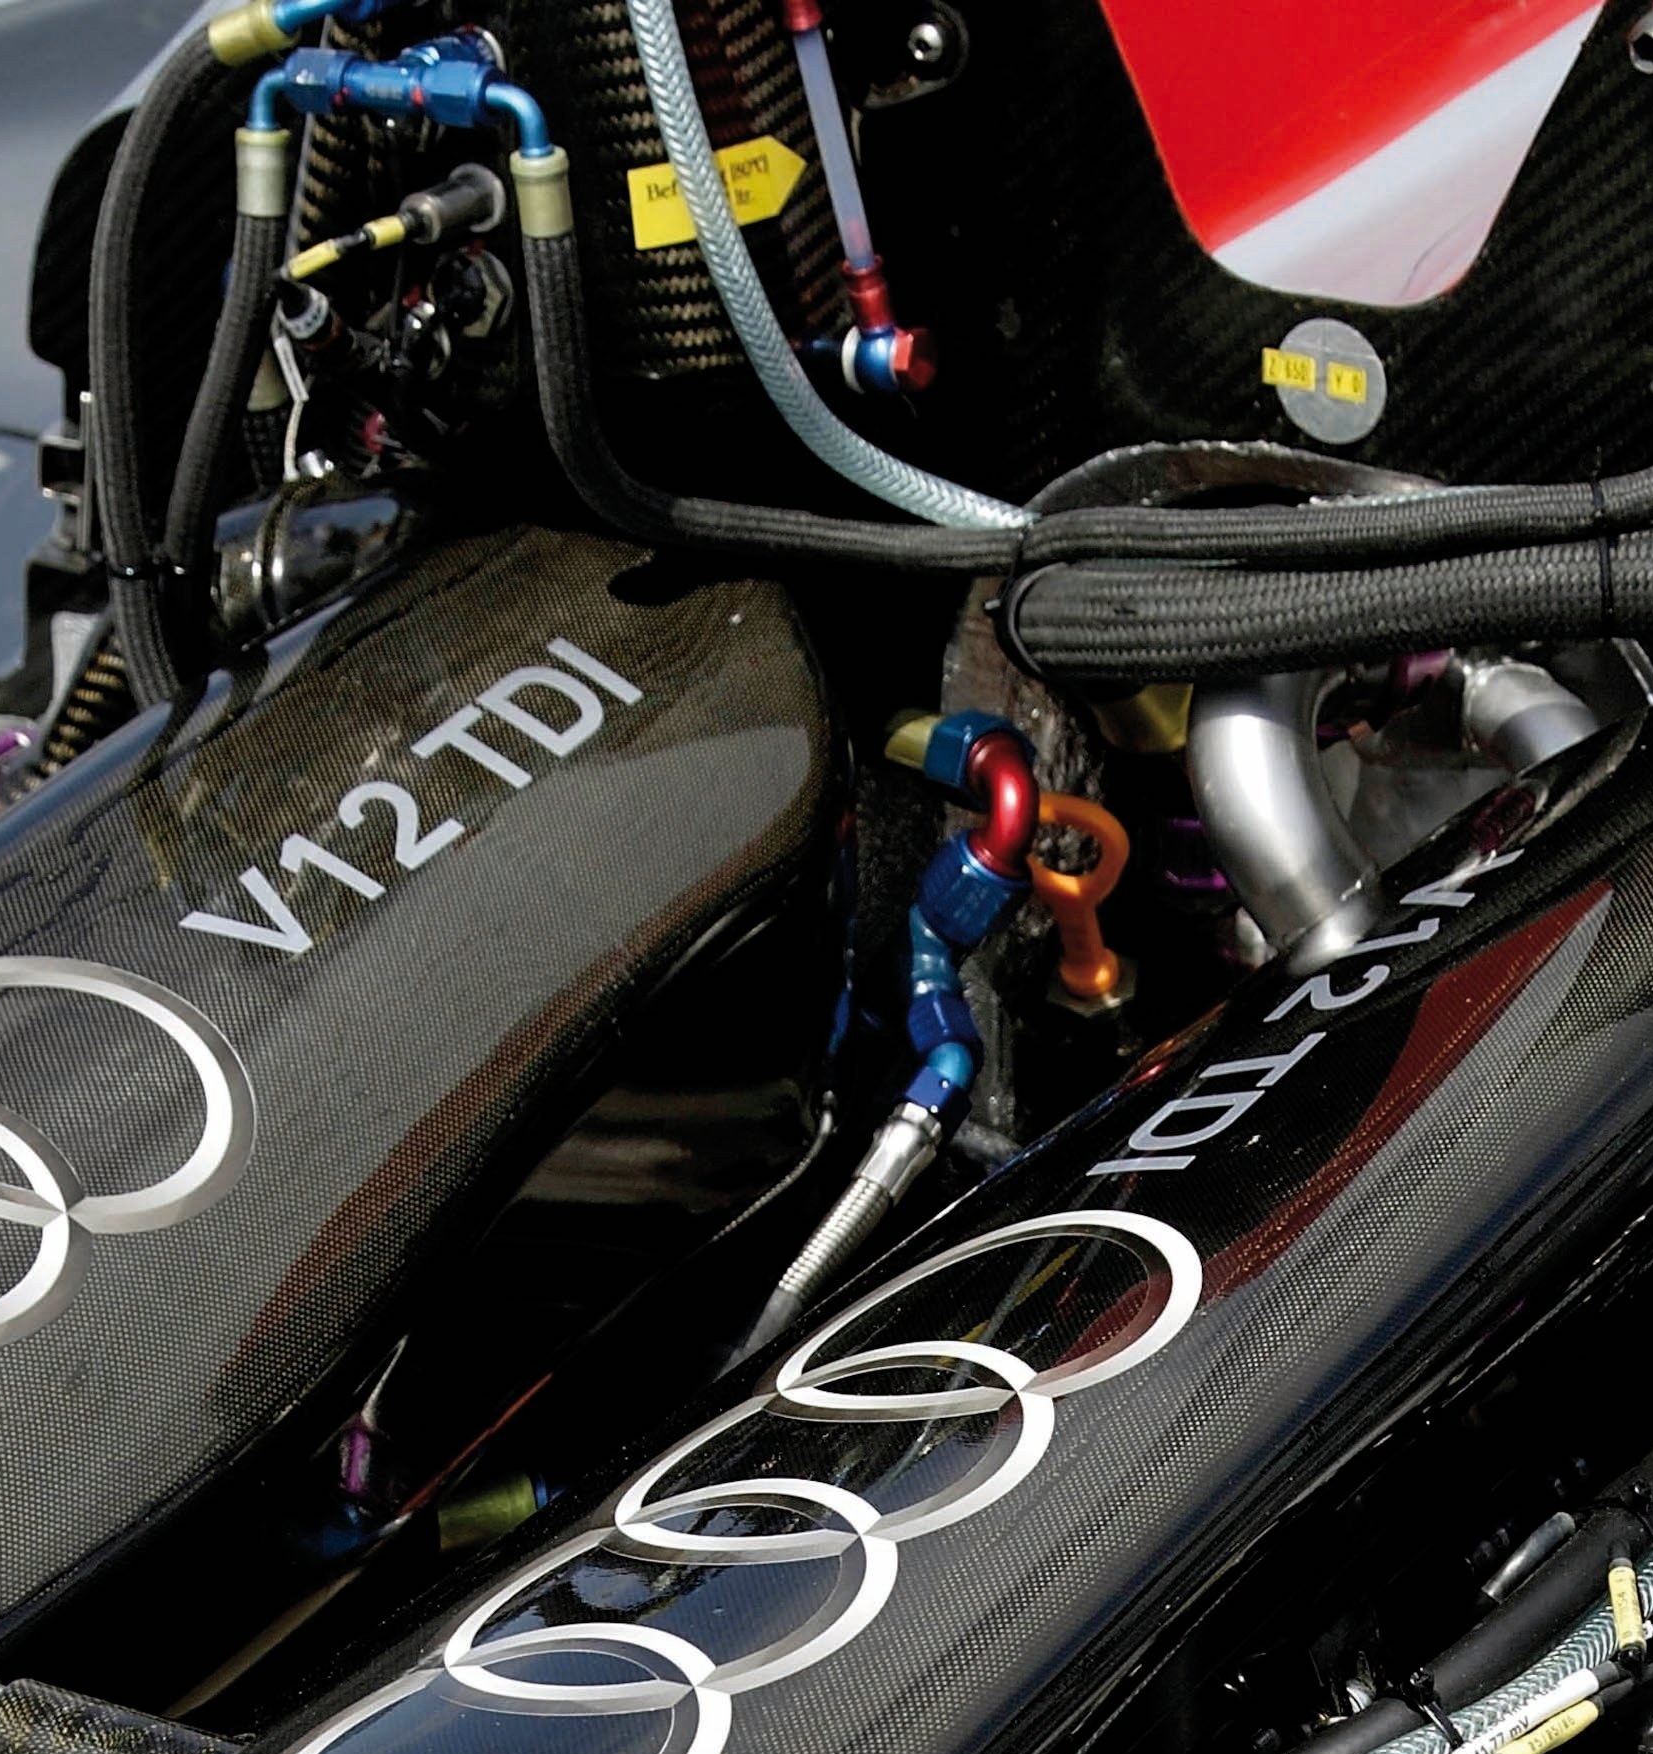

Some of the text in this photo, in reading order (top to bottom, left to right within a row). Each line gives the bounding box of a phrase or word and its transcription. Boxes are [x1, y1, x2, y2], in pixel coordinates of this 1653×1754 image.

[178, 636, 645, 957] V12 TDI
[1084, 846, 1527, 1178] V12 TDI
